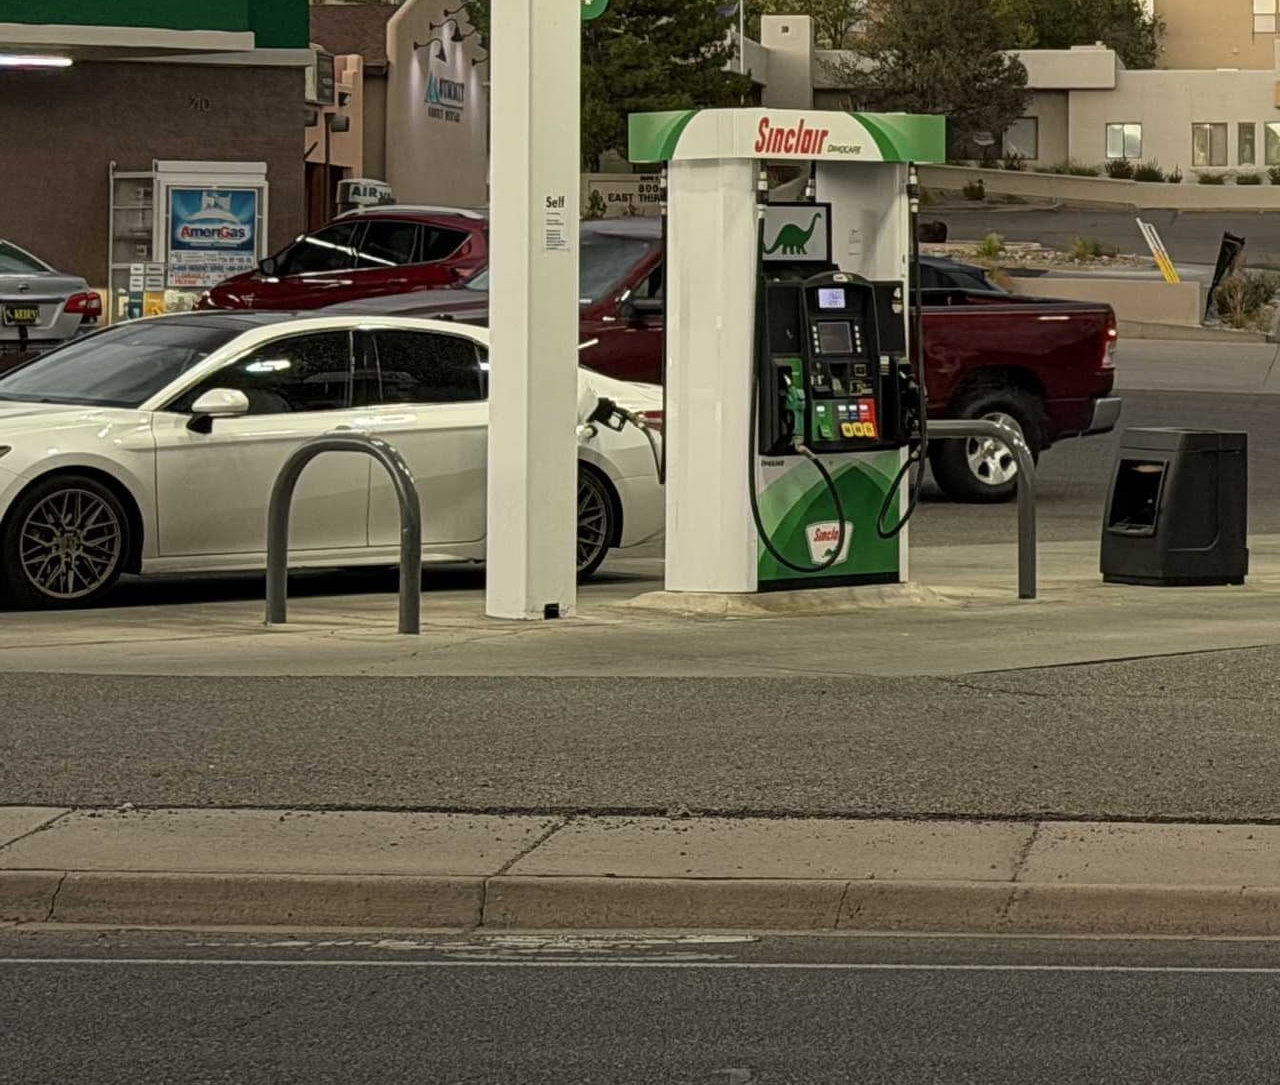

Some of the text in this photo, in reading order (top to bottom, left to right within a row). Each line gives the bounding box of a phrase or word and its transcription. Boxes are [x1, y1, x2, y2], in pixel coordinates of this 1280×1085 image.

[755, 116, 829, 154] Sinclair
[351, 186, 378, 198] AIR
[608, 193, 634, 203] EAST
[181, 226, 246, 239] AmeriGas
